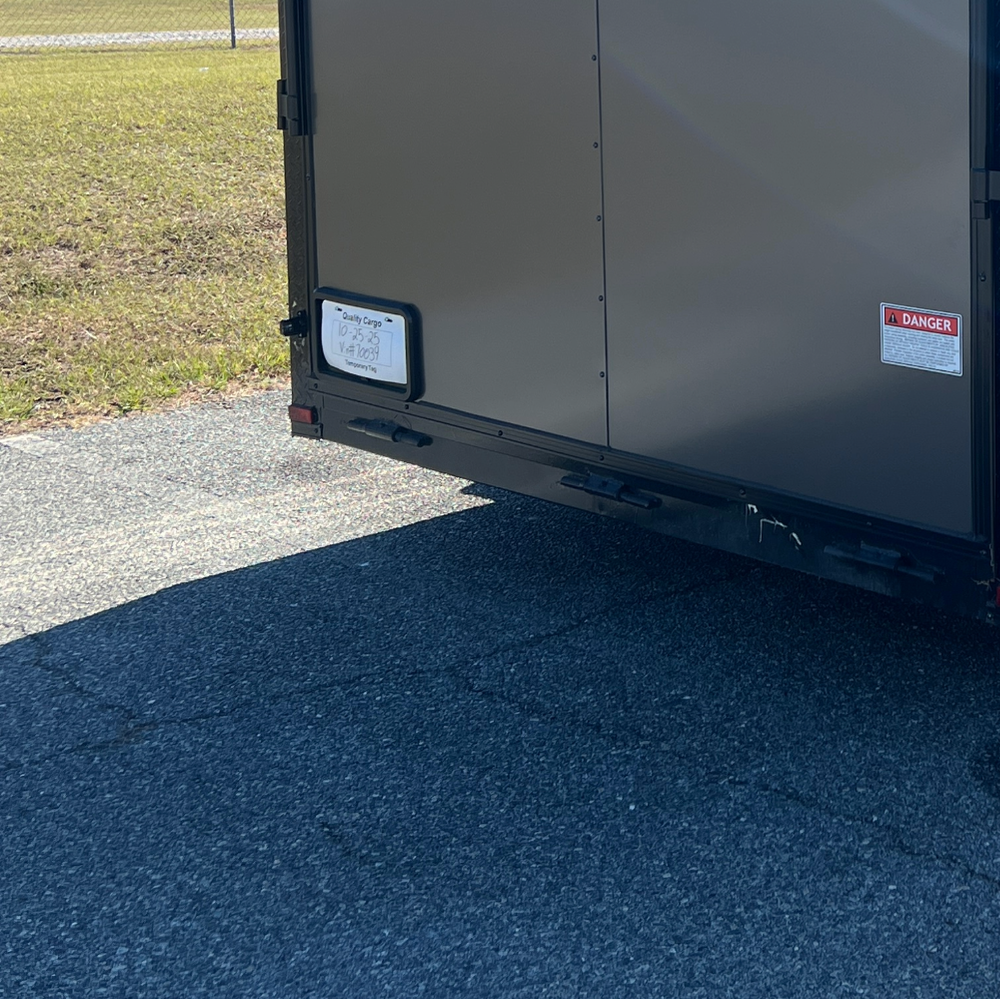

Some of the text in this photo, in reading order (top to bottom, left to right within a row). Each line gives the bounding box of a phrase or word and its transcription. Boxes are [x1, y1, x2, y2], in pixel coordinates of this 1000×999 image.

[342, 311, 382, 328] Quality Cargo
[902, 313, 952, 332] DANGER
[345, 359, 377, 373] Temporary Tag
